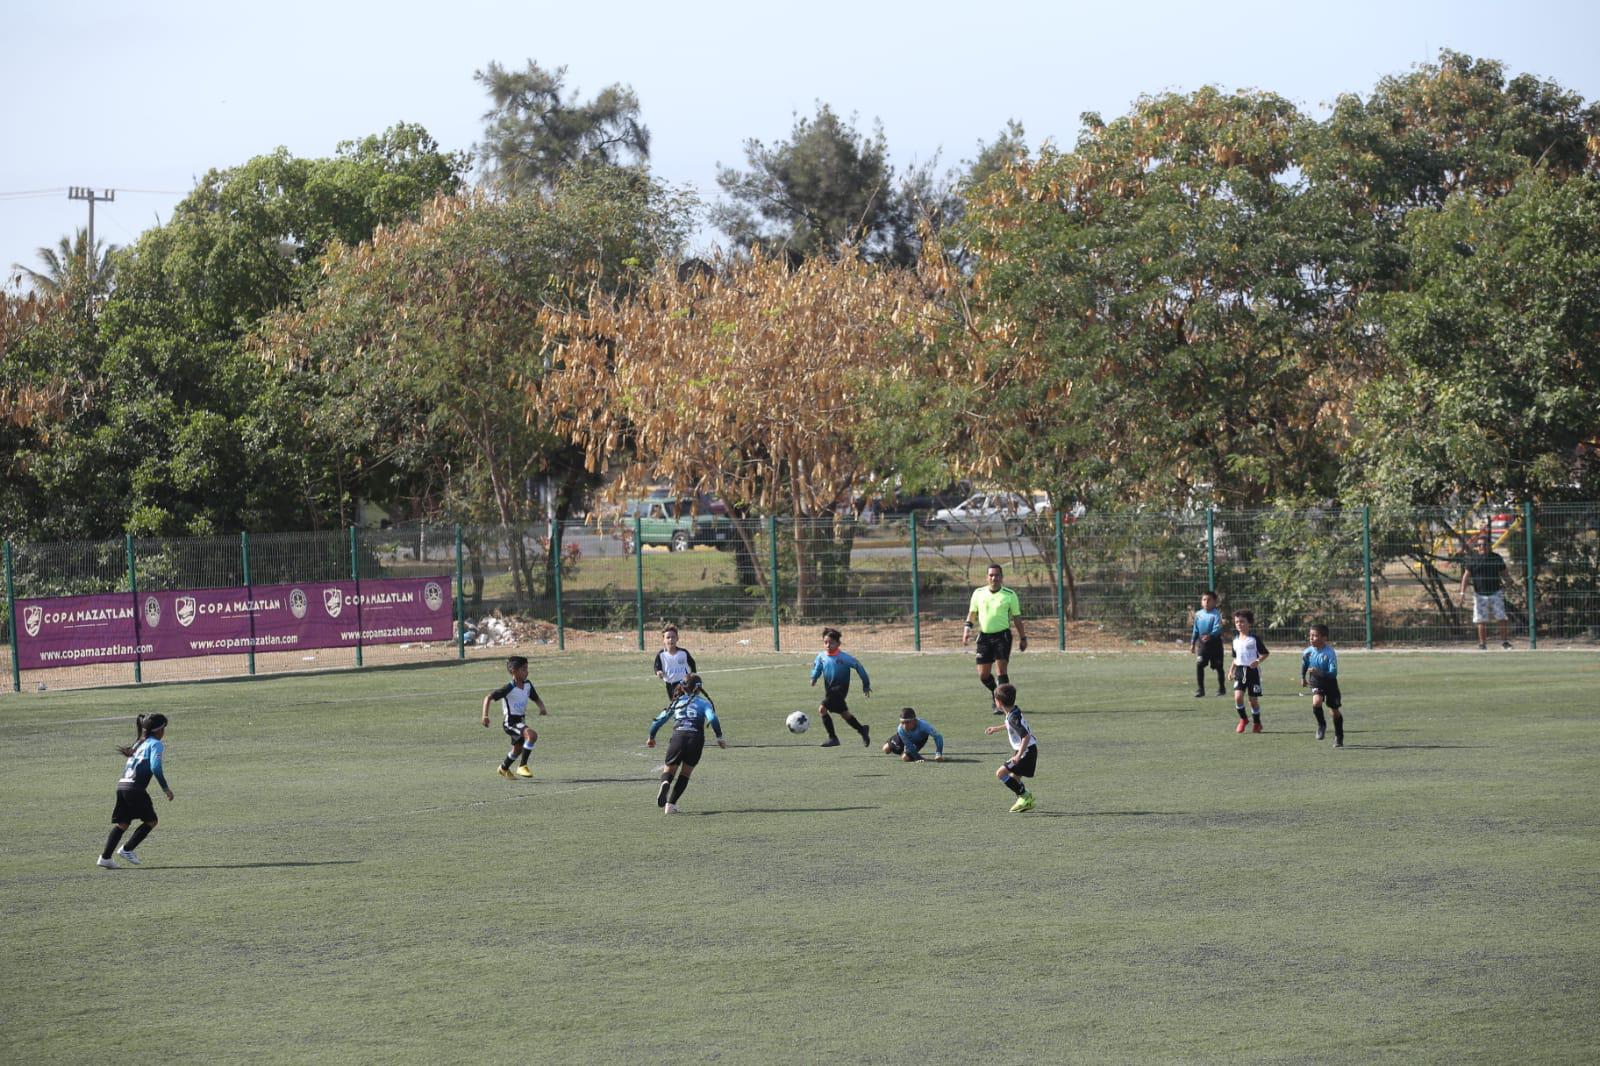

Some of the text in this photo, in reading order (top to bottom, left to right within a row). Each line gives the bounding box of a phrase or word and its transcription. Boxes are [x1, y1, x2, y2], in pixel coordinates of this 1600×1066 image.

[344, 593, 414, 606] COPA MAZATLAN
[199, 600, 281, 614] COPA MAZATLAN
[44, 612, 75, 624] COPA
[77, 607, 134, 621] MAZATLAN
[341, 626, 433, 640] www.copamazatlan.com
[190, 635, 298, 649] www.copamazatlan.com
[39, 644, 154, 661] www.copamazatlan.com
